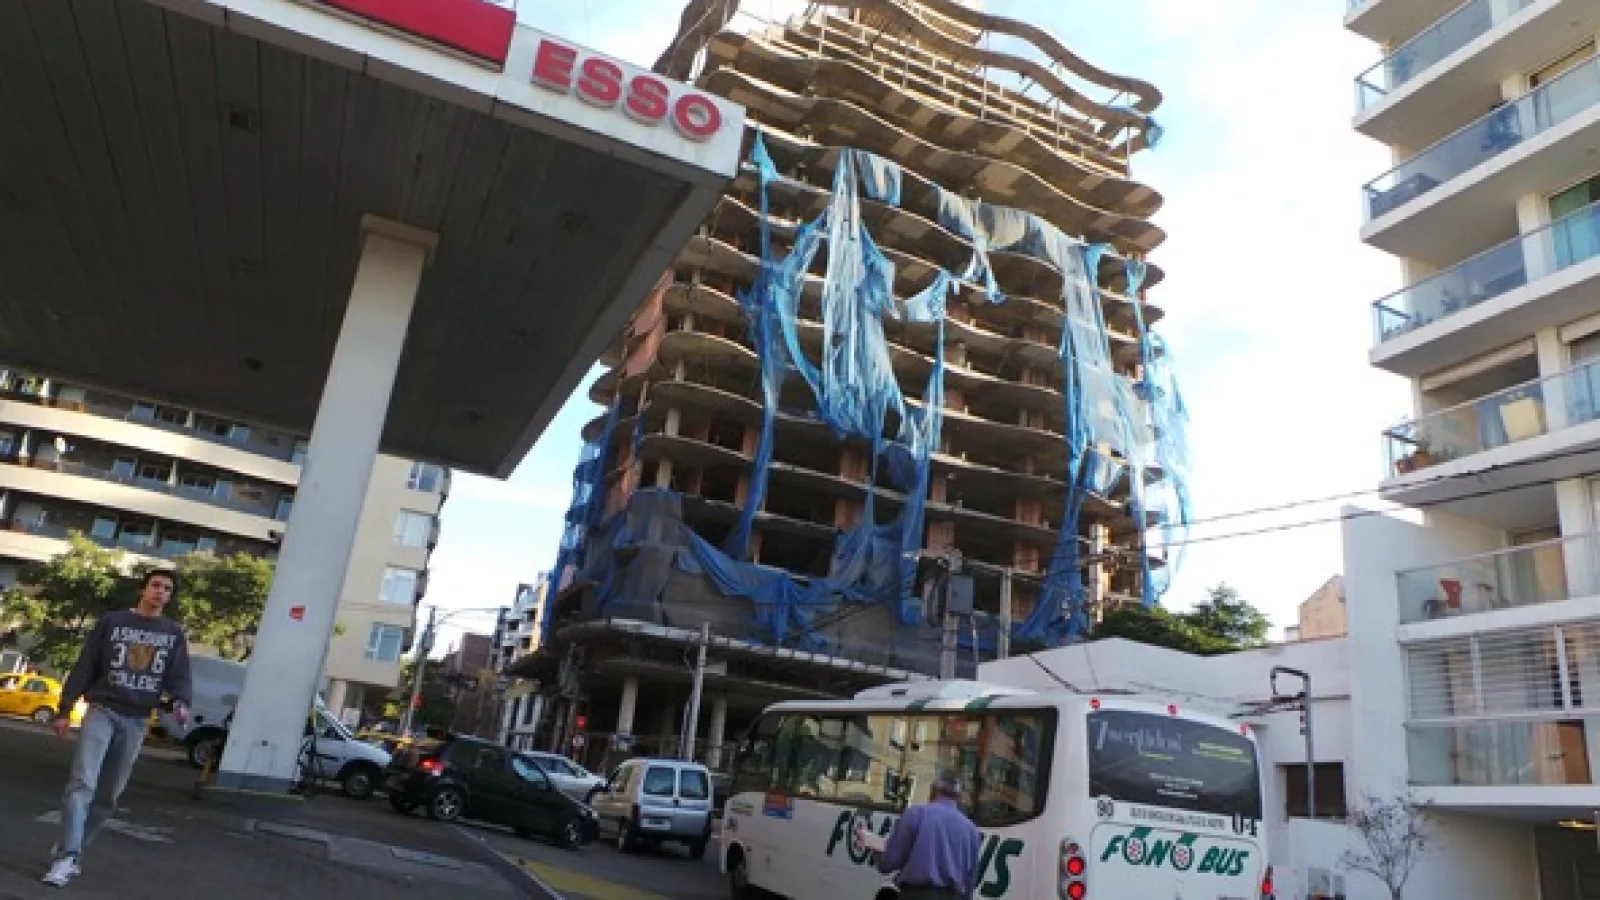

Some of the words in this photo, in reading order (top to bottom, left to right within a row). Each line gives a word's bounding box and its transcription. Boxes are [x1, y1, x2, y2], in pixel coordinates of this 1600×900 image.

[531, 38, 723, 142] ESSO
[110, 642, 127, 668] 3
[151, 648, 168, 674] 6
[1197, 846, 1249, 876] BUS
